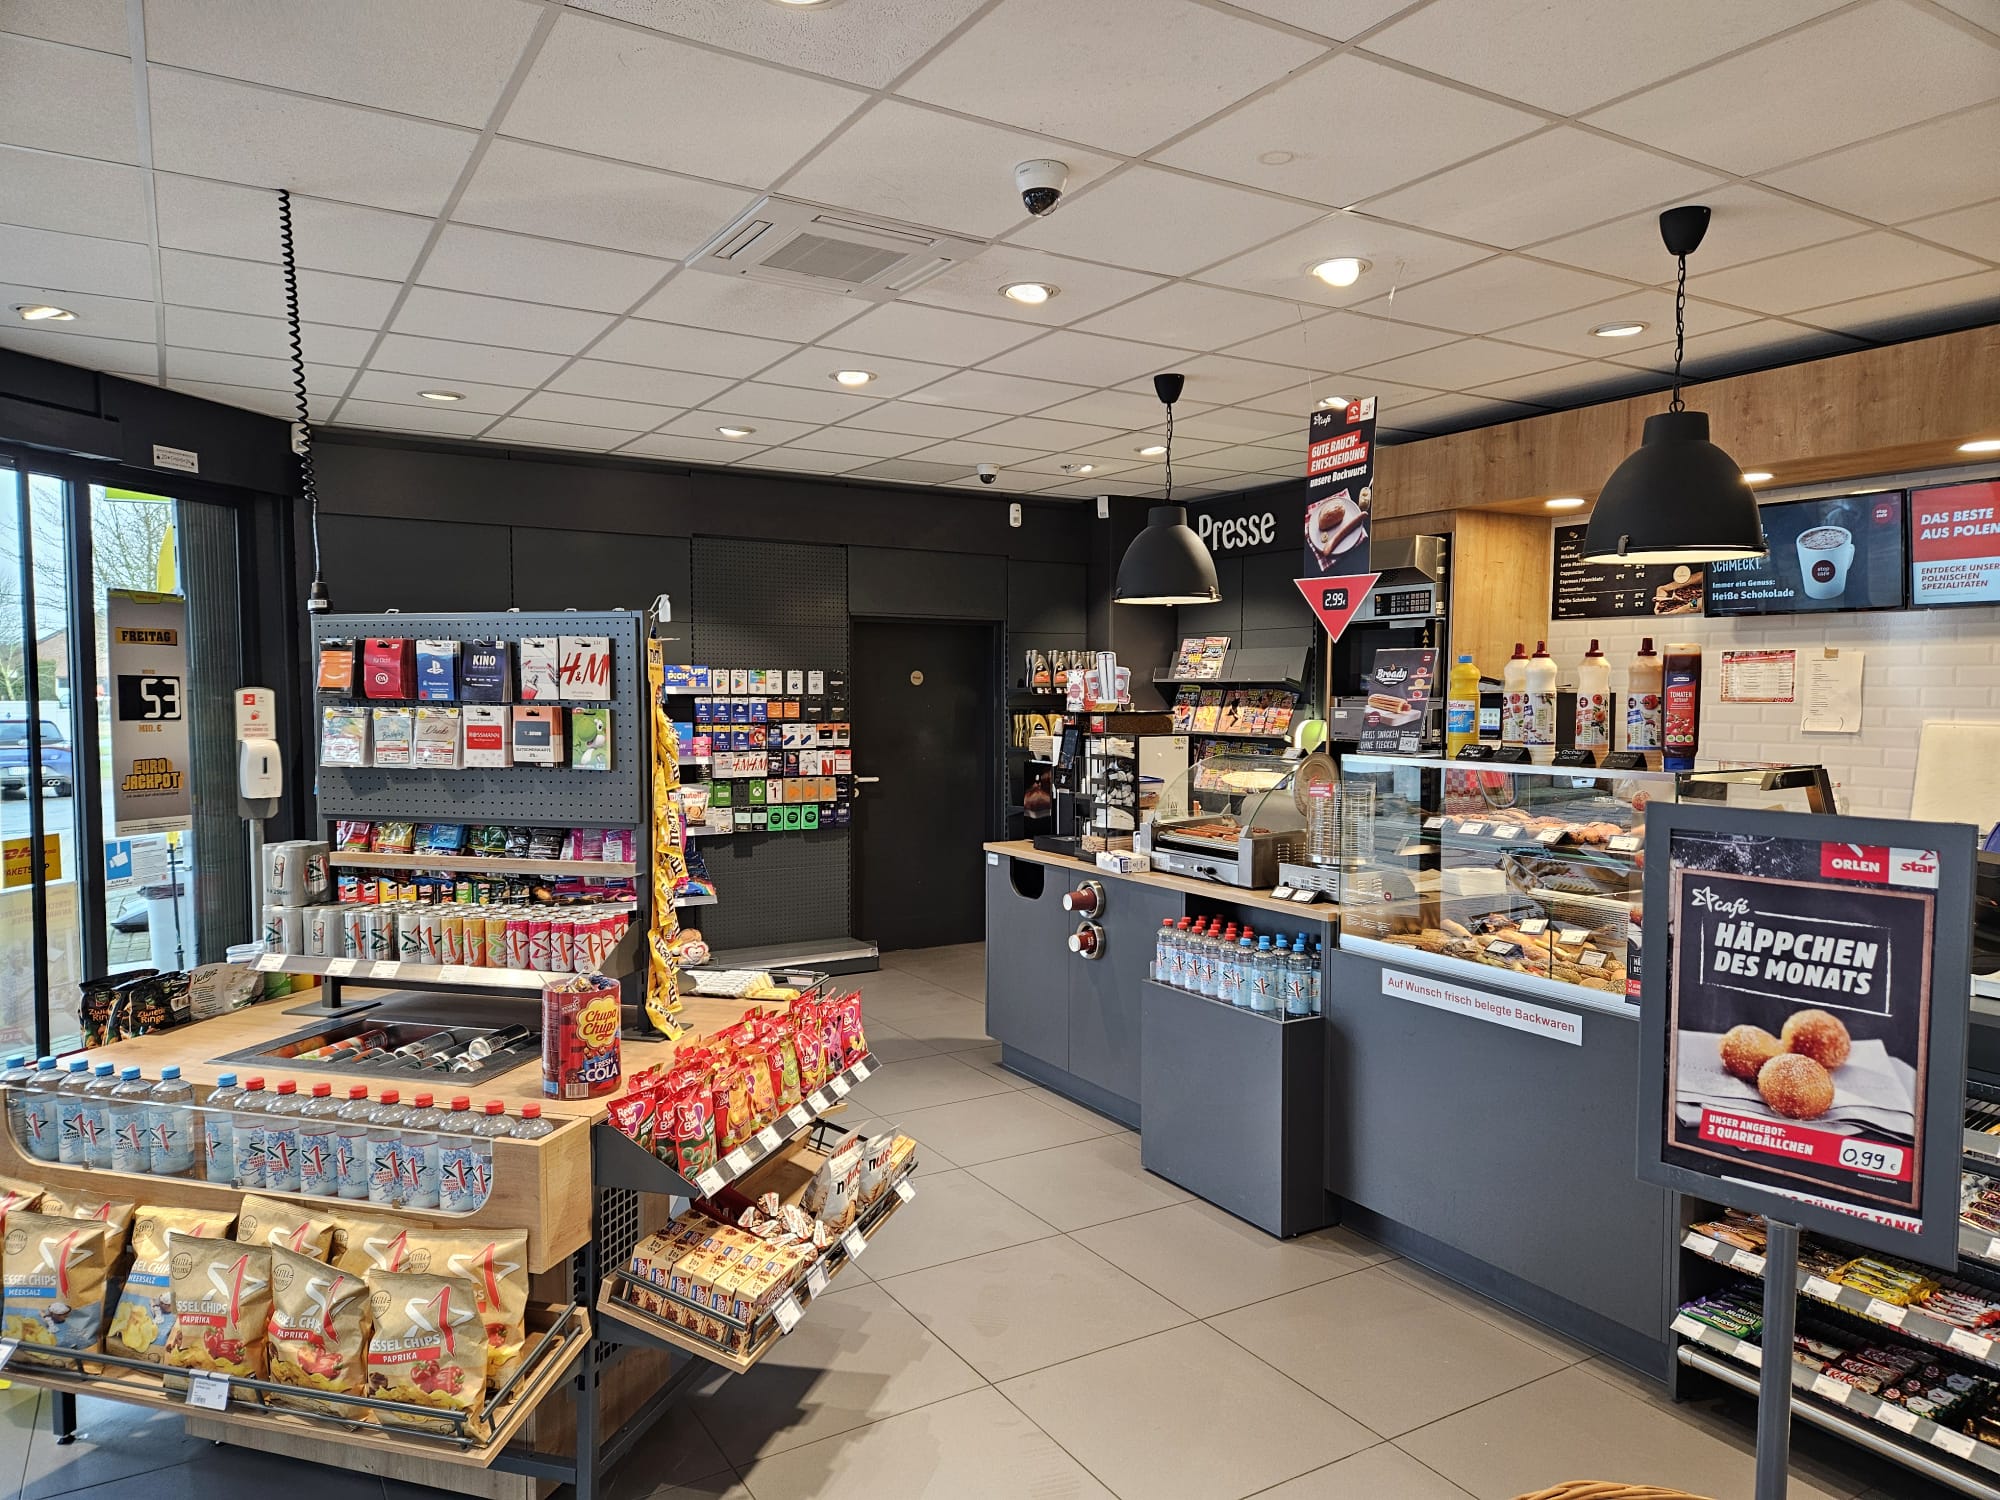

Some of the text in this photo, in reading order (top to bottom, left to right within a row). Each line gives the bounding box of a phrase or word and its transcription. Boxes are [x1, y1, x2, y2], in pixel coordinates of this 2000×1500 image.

[1311, 434, 1358, 458] GUTE BAUCH-
[1310, 446, 1366, 473] ENTSCHEIDUNG
[1310, 464, 1367, 488] unsere Bockwurst
[1920, 507, 1994, 525] DAS BESTE
[1198, 512, 1276, 550] Presse
[1920, 522, 2000, 540] AUS POLEN
[1920, 565, 1967, 574] ENTDECKE
[1921, 572, 1980, 582] POLNISCHEN
[1735, 580, 1746, 588] ein
[1747, 579, 1776, 587] Genuss:
[1712, 588, 1795, 601] Heiße Schokolade
[121, 630, 171, 642] FREITAG
[472, 655, 496, 666] KINO
[560, 651, 609, 686] H&M
[1376, 668, 1408, 681] Broady
[140, 678, 181, 719] 53
[133, 757, 168, 775] EURO
[121, 771, 180, 791] JACKPOT
[1831, 858, 1880, 873] ORLEN
[1899, 860, 1937, 874] star
[1713, 920, 1878, 969] HÄPPCHEN
[1713, 950, 1873, 995] DES MONATS
[1387, 976, 1575, 1033] Auf Wunsch frisch belegte Backwaren
[585, 1008, 617, 1023] Chupa
[582, 1019, 617, 1036] Chups
[594, 1057, 614, 1070] FRESH
[585, 1064, 619, 1082] COLA
[1708, 1113, 1787, 1138] UNSER ANGEBOT:
[1706, 1124, 1814, 1156] 3 QUARKBÄLLCHEN
[1842, 1148, 1897, 1171] 0,99 €
[29, 1274, 57, 1286] CHIPS
[201, 1302, 228, 1314] CHIPS
[182, 1315, 211, 1324] PAPRIKA
[277, 1329, 310, 1340] PAPRIKA
[404, 1334, 441, 1349] CHIPS
[382, 1351, 418, 1364] PAPRIKA
[1842, 1359, 1878, 1375] KitKat
[1828, 1367, 1863, 1386] KitKat
